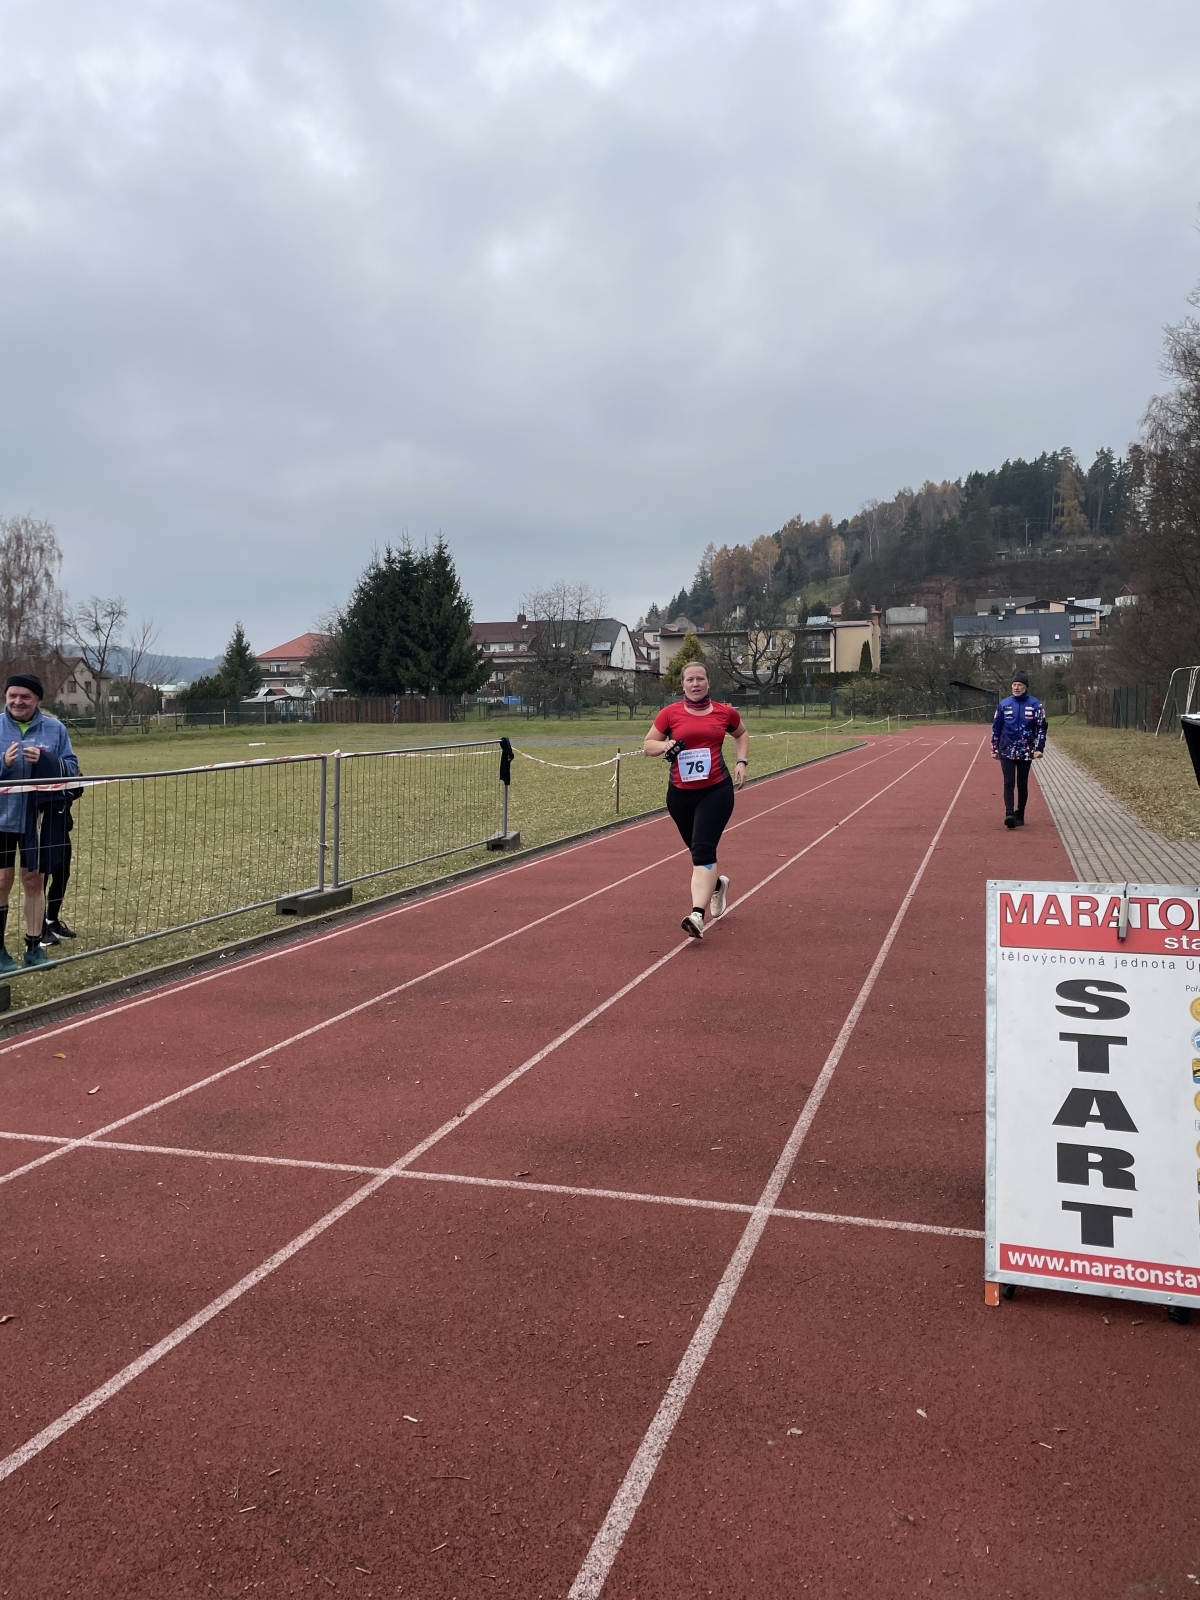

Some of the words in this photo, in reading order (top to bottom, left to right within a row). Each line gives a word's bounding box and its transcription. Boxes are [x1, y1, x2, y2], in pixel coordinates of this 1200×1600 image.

[686, 760, 705, 775] 76
[1000, 893, 1200, 931] MARATO
[1001, 951, 1106, 966] tělovýchovná
[1114, 957, 1176, 970] jednota
[1186, 959, 1200, 973] Ú
[1185, 984, 1200, 993] Poř
[1051, 978, 1139, 1248] START
